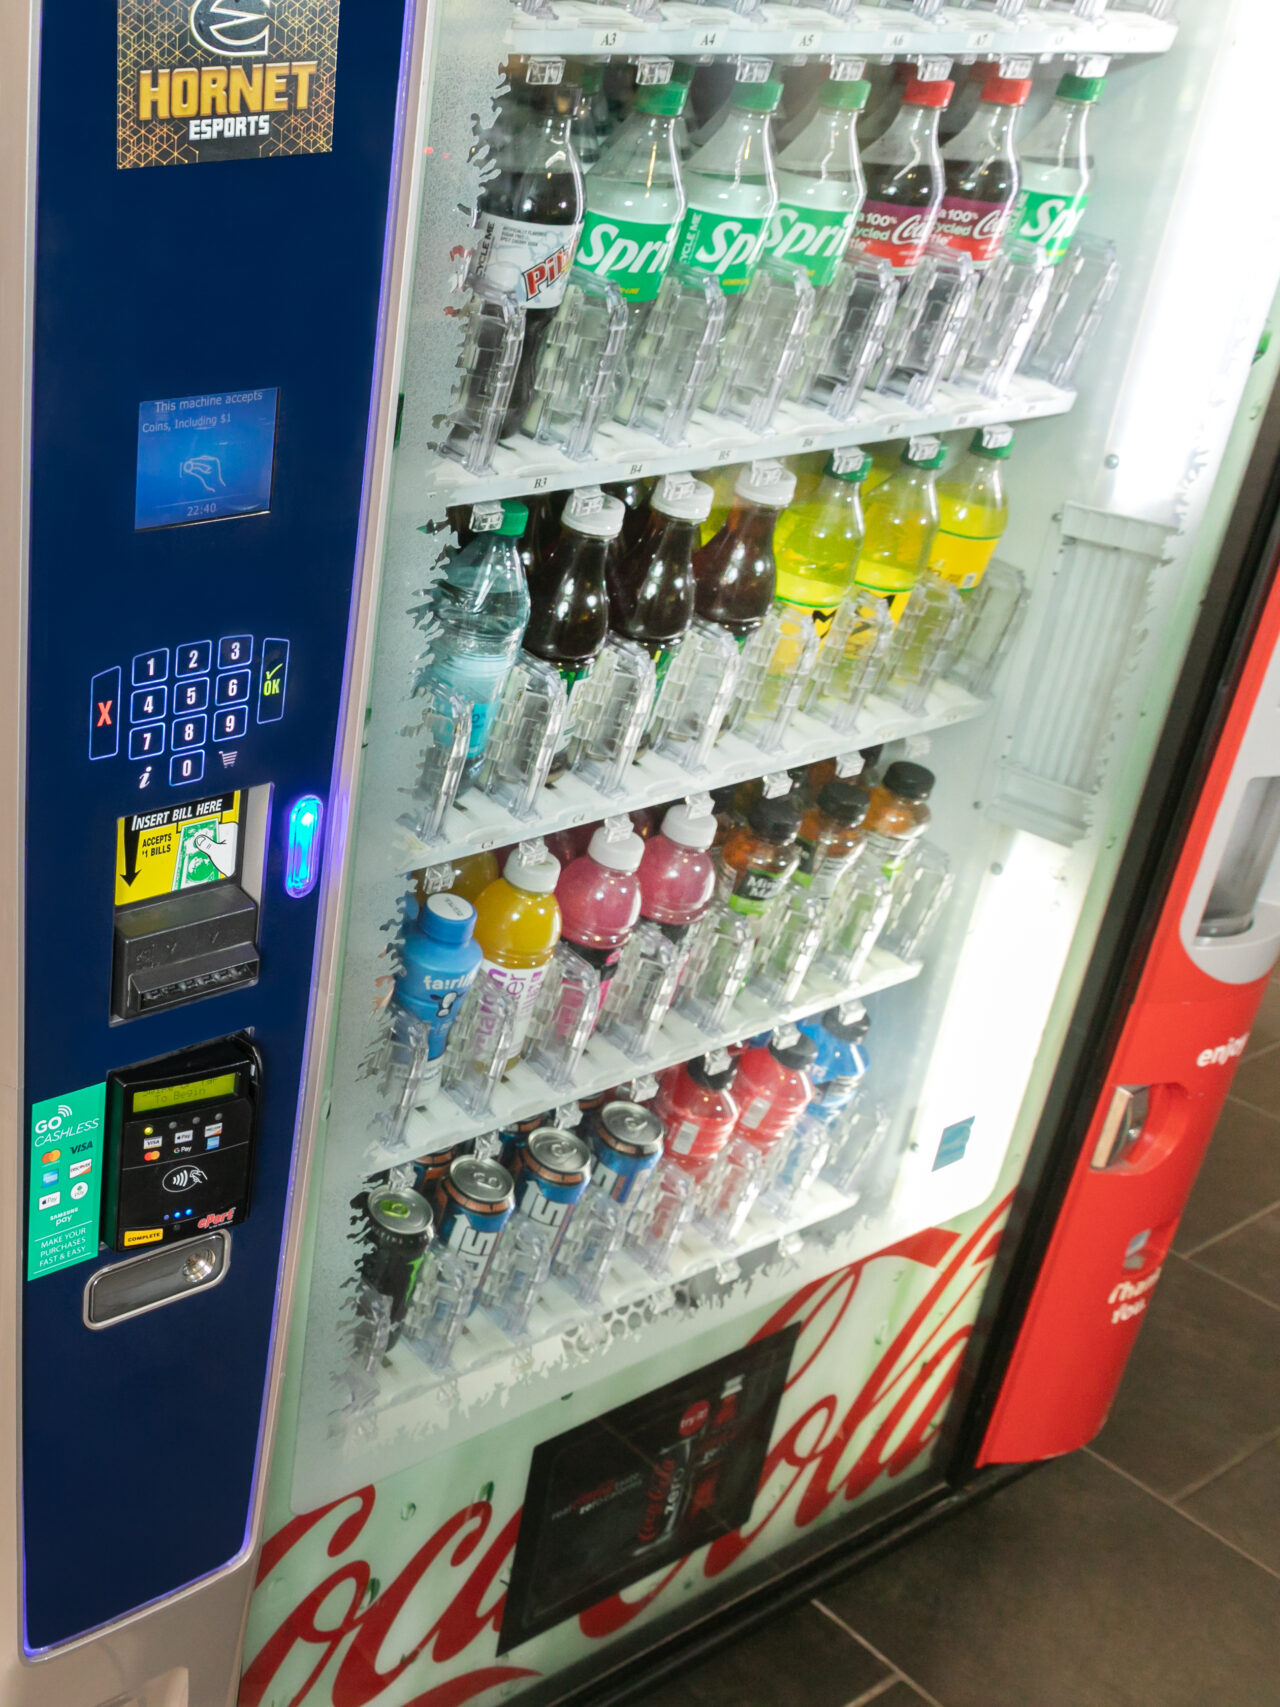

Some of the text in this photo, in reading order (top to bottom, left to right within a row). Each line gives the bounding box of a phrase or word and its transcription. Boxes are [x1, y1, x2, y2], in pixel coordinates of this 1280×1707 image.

[600, 32, 617, 47] A3
[699, 32, 716, 47] A4
[798, 32, 814, 47] A5
[889, 32, 905, 47] A6
[139, 61, 317, 120] HORNET
[189, 115, 270, 141] ESPORTS
[155, 391, 263, 413] This machine accepts
[142, 413, 231, 433] Coins, Including $1
[630, 464, 643, 475] B4
[534, 477, 549, 490] B3
[187, 503, 216, 516] 22:40
[147, 642, 240, 676] 1 2 3
[143, 678, 280, 714] 4 5 6 OK
[143, 715, 234, 751] 7 8 9
[182, 760, 191, 778] 0
[131, 799, 223, 832] INSERT BILL HERE
[142, 833, 172, 848] ACCEPTS
[150, 844, 171, 857] BILLS
[173, 1087, 206, 1101] Begin
[34, 1118, 100, 1147] CASHLESS
[35, 1116, 63, 1134] GO
[70, 1141, 94, 1155] VISA
[181, 1146, 192, 1154] Pay
[50, 1207, 79, 1222] SAMSUNG
[55, 1216, 72, 1226] pay
[198, 1207, 235, 1230] ePort
[41, 1227, 86, 1249] MAKE YOUR
[127, 1232, 161, 1243] COMPLETE
[40, 1237, 86, 1258] PURCHASES
[39, 1247, 86, 1268] FAST EASY
